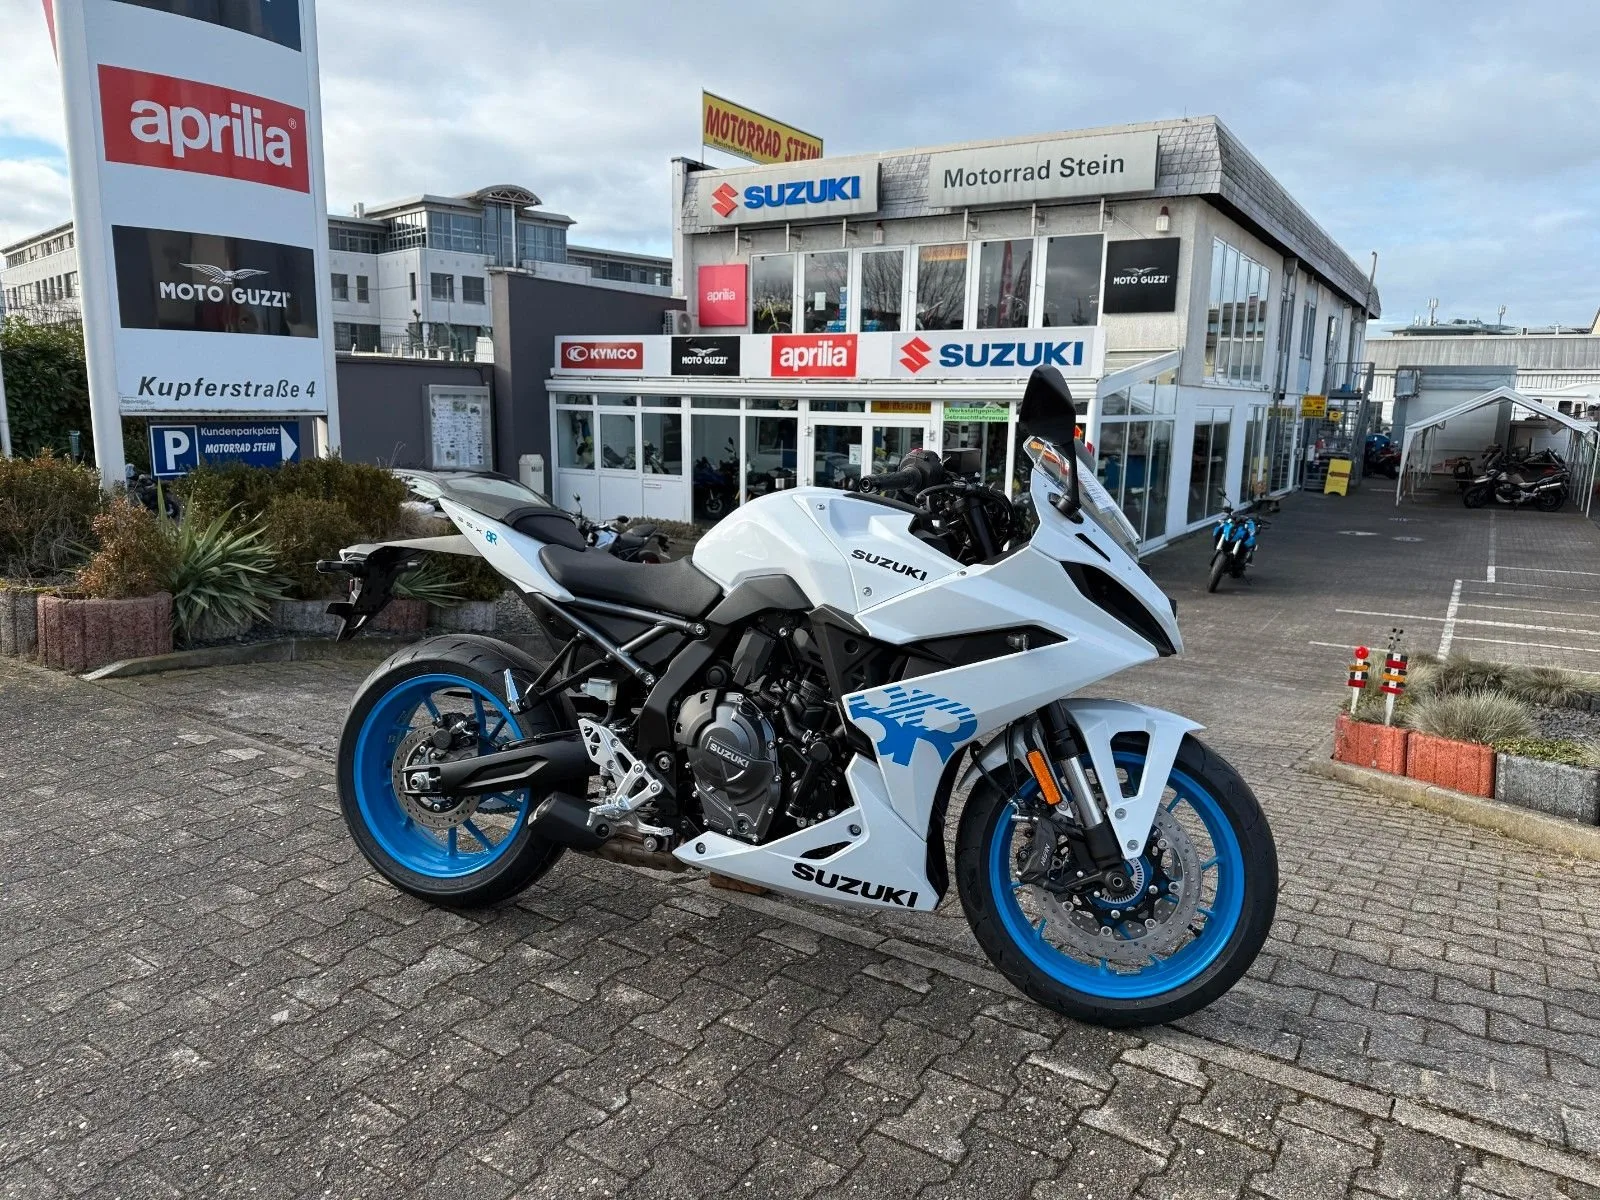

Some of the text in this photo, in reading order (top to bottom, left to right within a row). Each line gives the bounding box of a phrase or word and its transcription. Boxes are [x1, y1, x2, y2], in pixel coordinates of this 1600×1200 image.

[130, 100, 293, 168] aprilia
[705, 104, 782, 158] MOTORRAD
[944, 154, 1124, 188] Motorrad Stein
[744, 175, 860, 209] SUZUKI
[1113, 275, 1168, 285] MOTO GUZZI
[159, 281, 287, 308] MOTO GUZZI
[706, 289, 736, 303] aprilia
[590, 348, 637, 360] KYMCO
[682, 356, 728, 365] MOTO GUZZI
[780, 340, 847, 372] aprilia
[939, 341, 1083, 367] SUZUKI
[138, 376, 316, 401] Kupferstraße 4
[200, 426, 280, 437] Kundenparkplatz
[163, 430, 190, 470] P
[205, 442, 276, 453] MOTORRAD STEIN
[851, 549, 928, 581] SUZUKI
[709, 742, 750, 768] SUZUKI
[792, 863, 918, 908] SUZUKI
